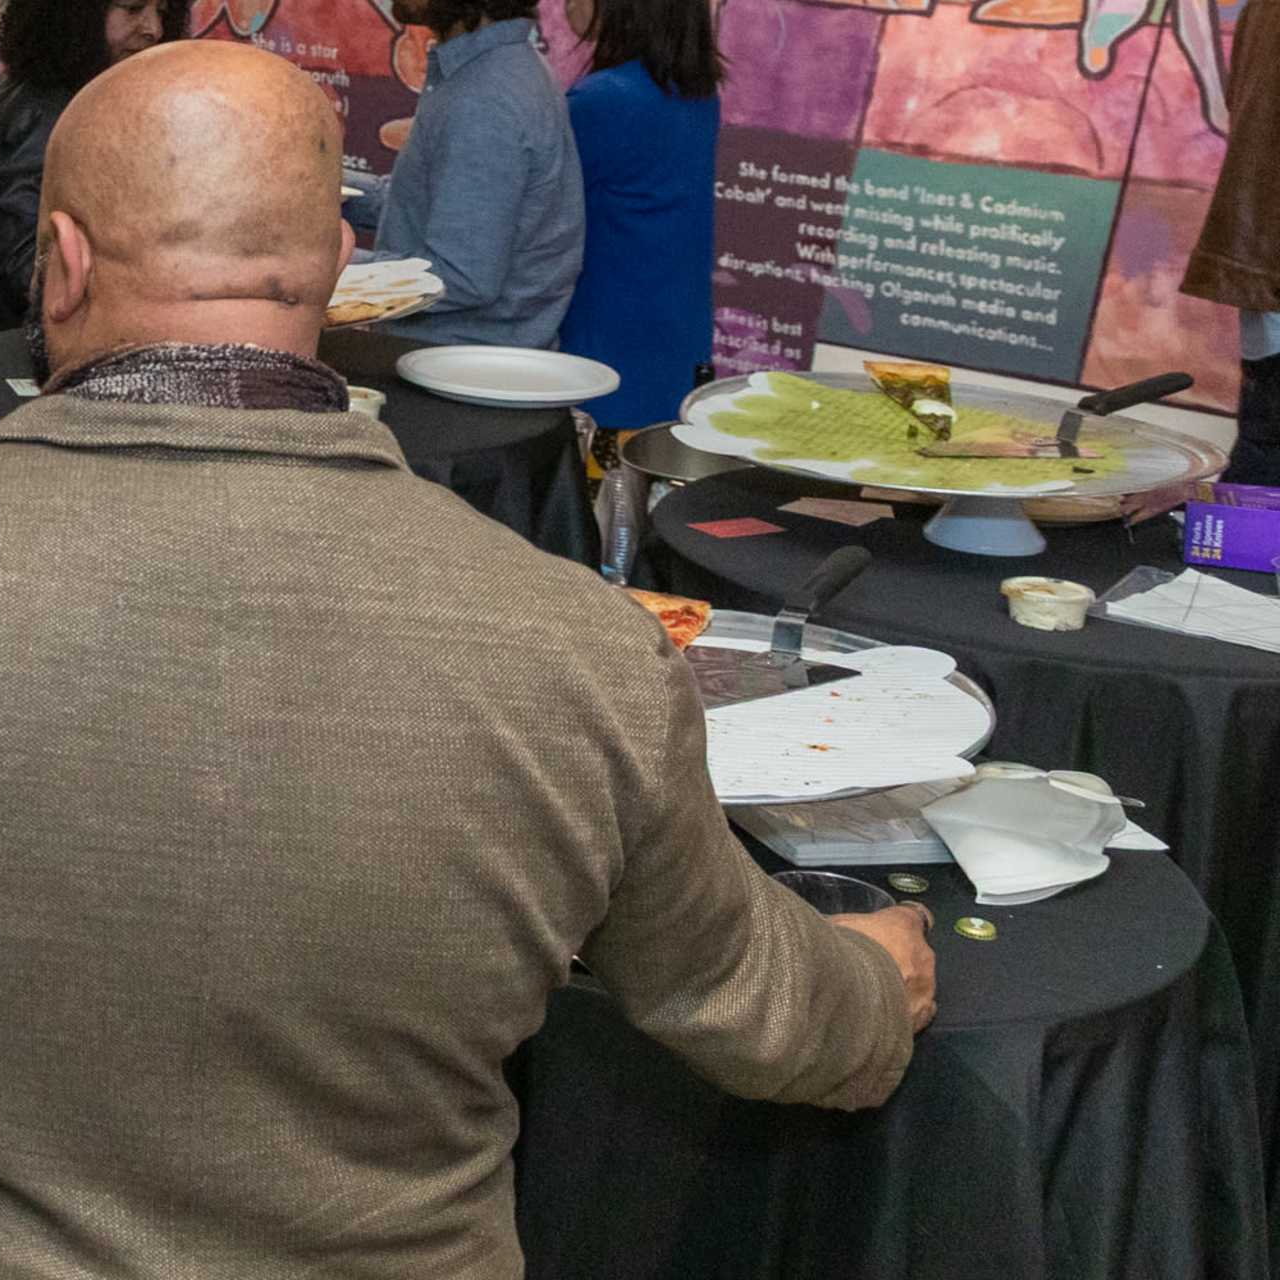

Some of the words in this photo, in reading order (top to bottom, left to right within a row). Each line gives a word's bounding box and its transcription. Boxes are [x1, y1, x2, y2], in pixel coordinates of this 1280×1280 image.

[280, 38, 291, 53] is
[296, 43, 306, 55] a
[309, 42, 339, 60] star
[311, 69, 351, 88] aruth
[738, 161, 767, 180] She
[771, 165, 831, 191] formed
[834, 175, 861, 195] the
[864, 177, 909, 202] band
[959, 193, 974, 210] &
[980, 196, 1065, 223] Cadmium
[774, 192, 807, 211] and
[810, 196, 850, 218] went
[853, 203, 916, 232] missing
[919, 209, 965, 235] while
[968, 218, 1065, 253] prolifically
[884, 235, 917, 253] and
[920, 240, 1002, 270] releasing
[1005, 252, 1062, 275] music.
[795, 242, 837, 265] With
[959, 268, 1063, 302] spectacular
[810, 266, 876, 299] hacking
[879, 281, 958, 309] Olgaruth
[961, 294, 1017, 316] media
[1021, 306, 1058, 326] and
[771, 316, 803, 337] best
[1191, 521, 1202, 545] Forks
[1202, 514, 1214, 547] Spoons
[1212, 519, 1224, 548] Knives
